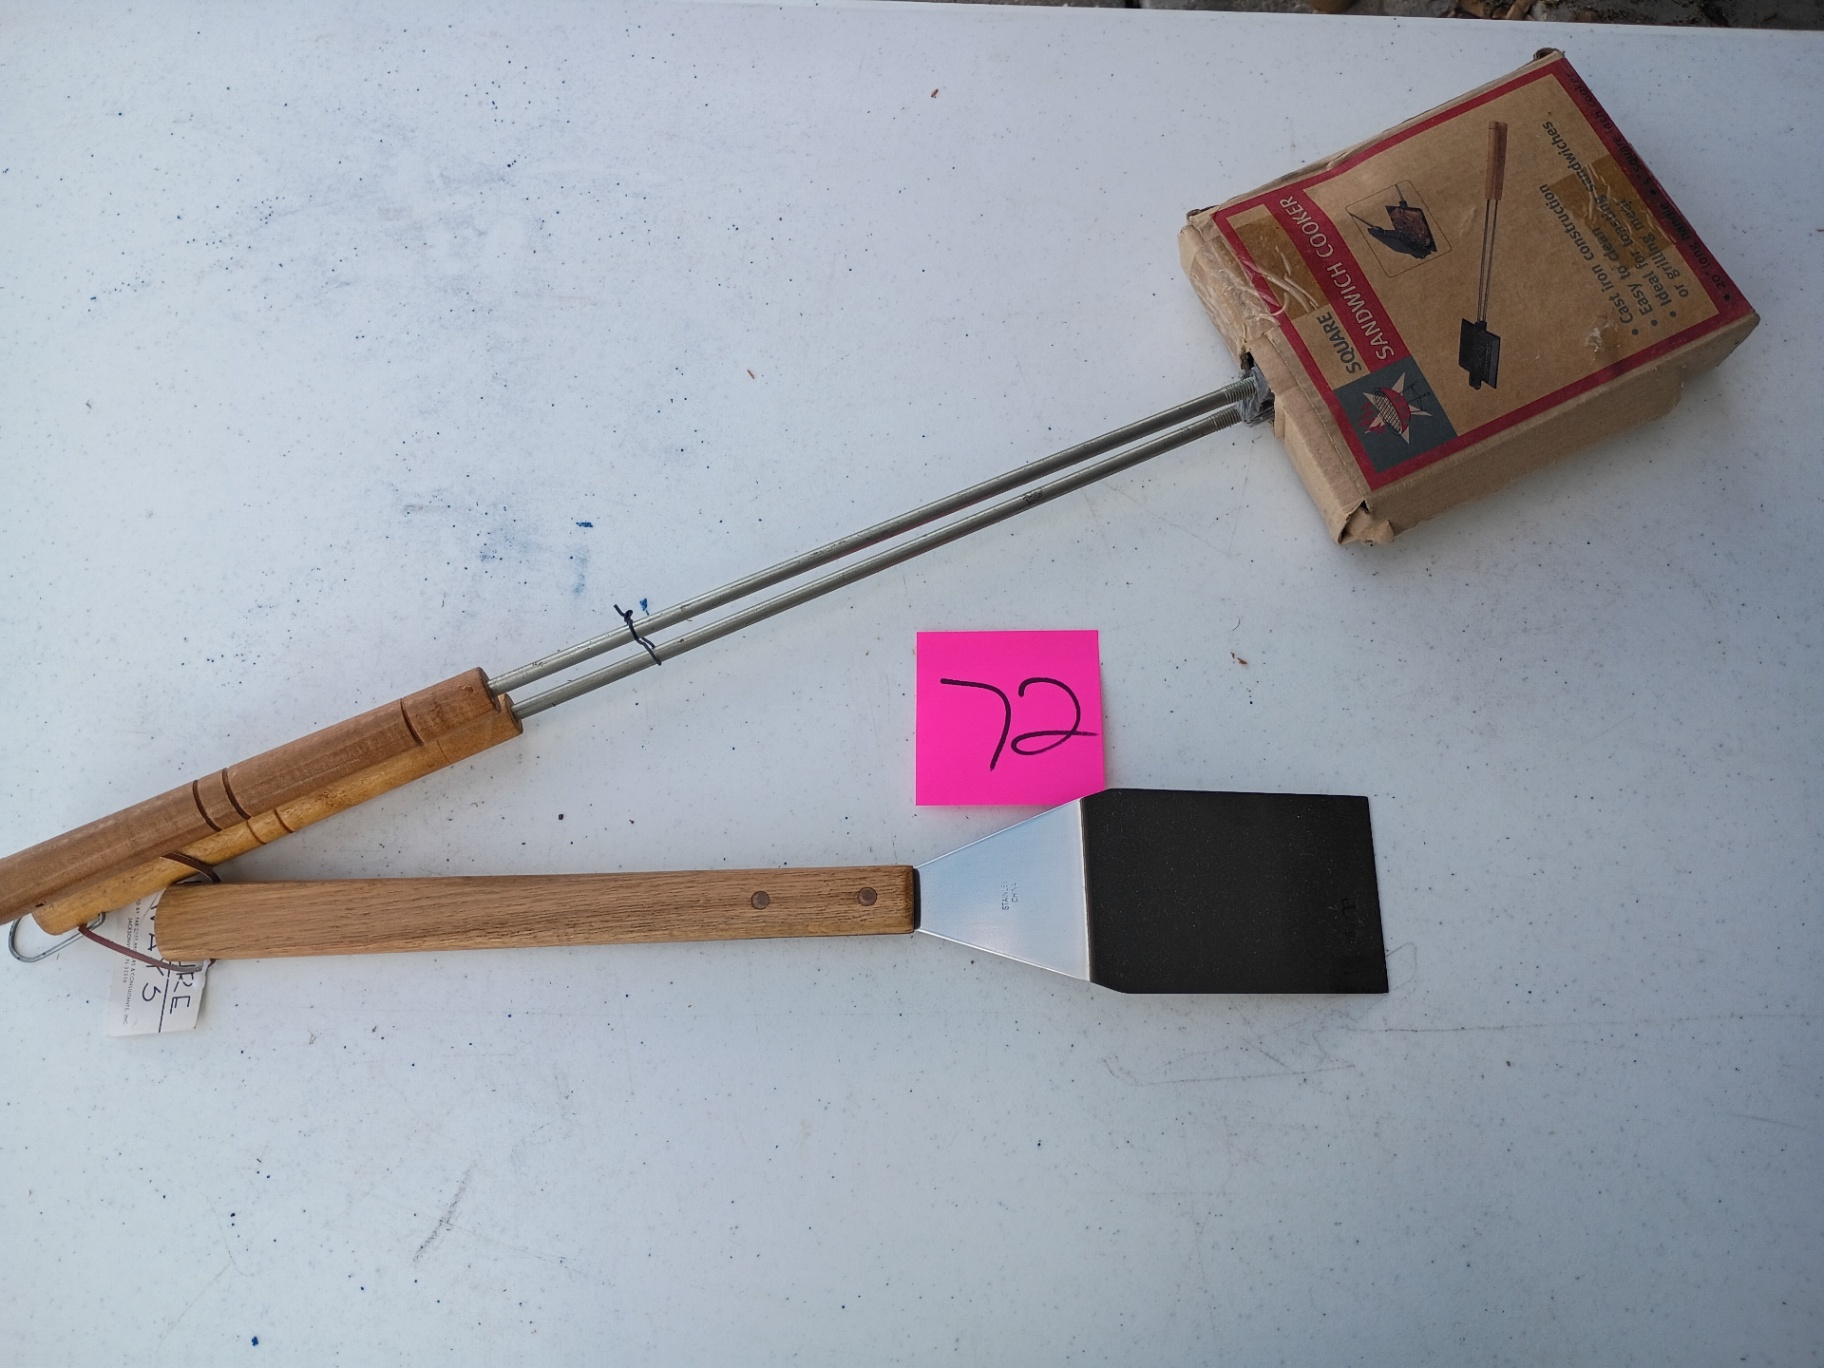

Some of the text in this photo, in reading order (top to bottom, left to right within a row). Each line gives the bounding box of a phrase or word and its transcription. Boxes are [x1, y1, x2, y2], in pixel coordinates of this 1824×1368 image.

[1613, 136, 1640, 172] square
[1542, 121, 1672, 306] Ideal for toasting sandwiches
[1661, 203, 1690, 240] handle
[1279, 196, 1395, 360] SANDWICH COOKER
[1540, 184, 1633, 323] Cast iron construction
[1592, 227, 1653, 315] Easy to clean
[1640, 234, 1680, 279] grilling
[1689, 242, 1711, 268] long
[1674, 284, 1689, 297] or
[1316, 311, 1361, 374] SQUARE
[940, 677, 1098, 771] 72
